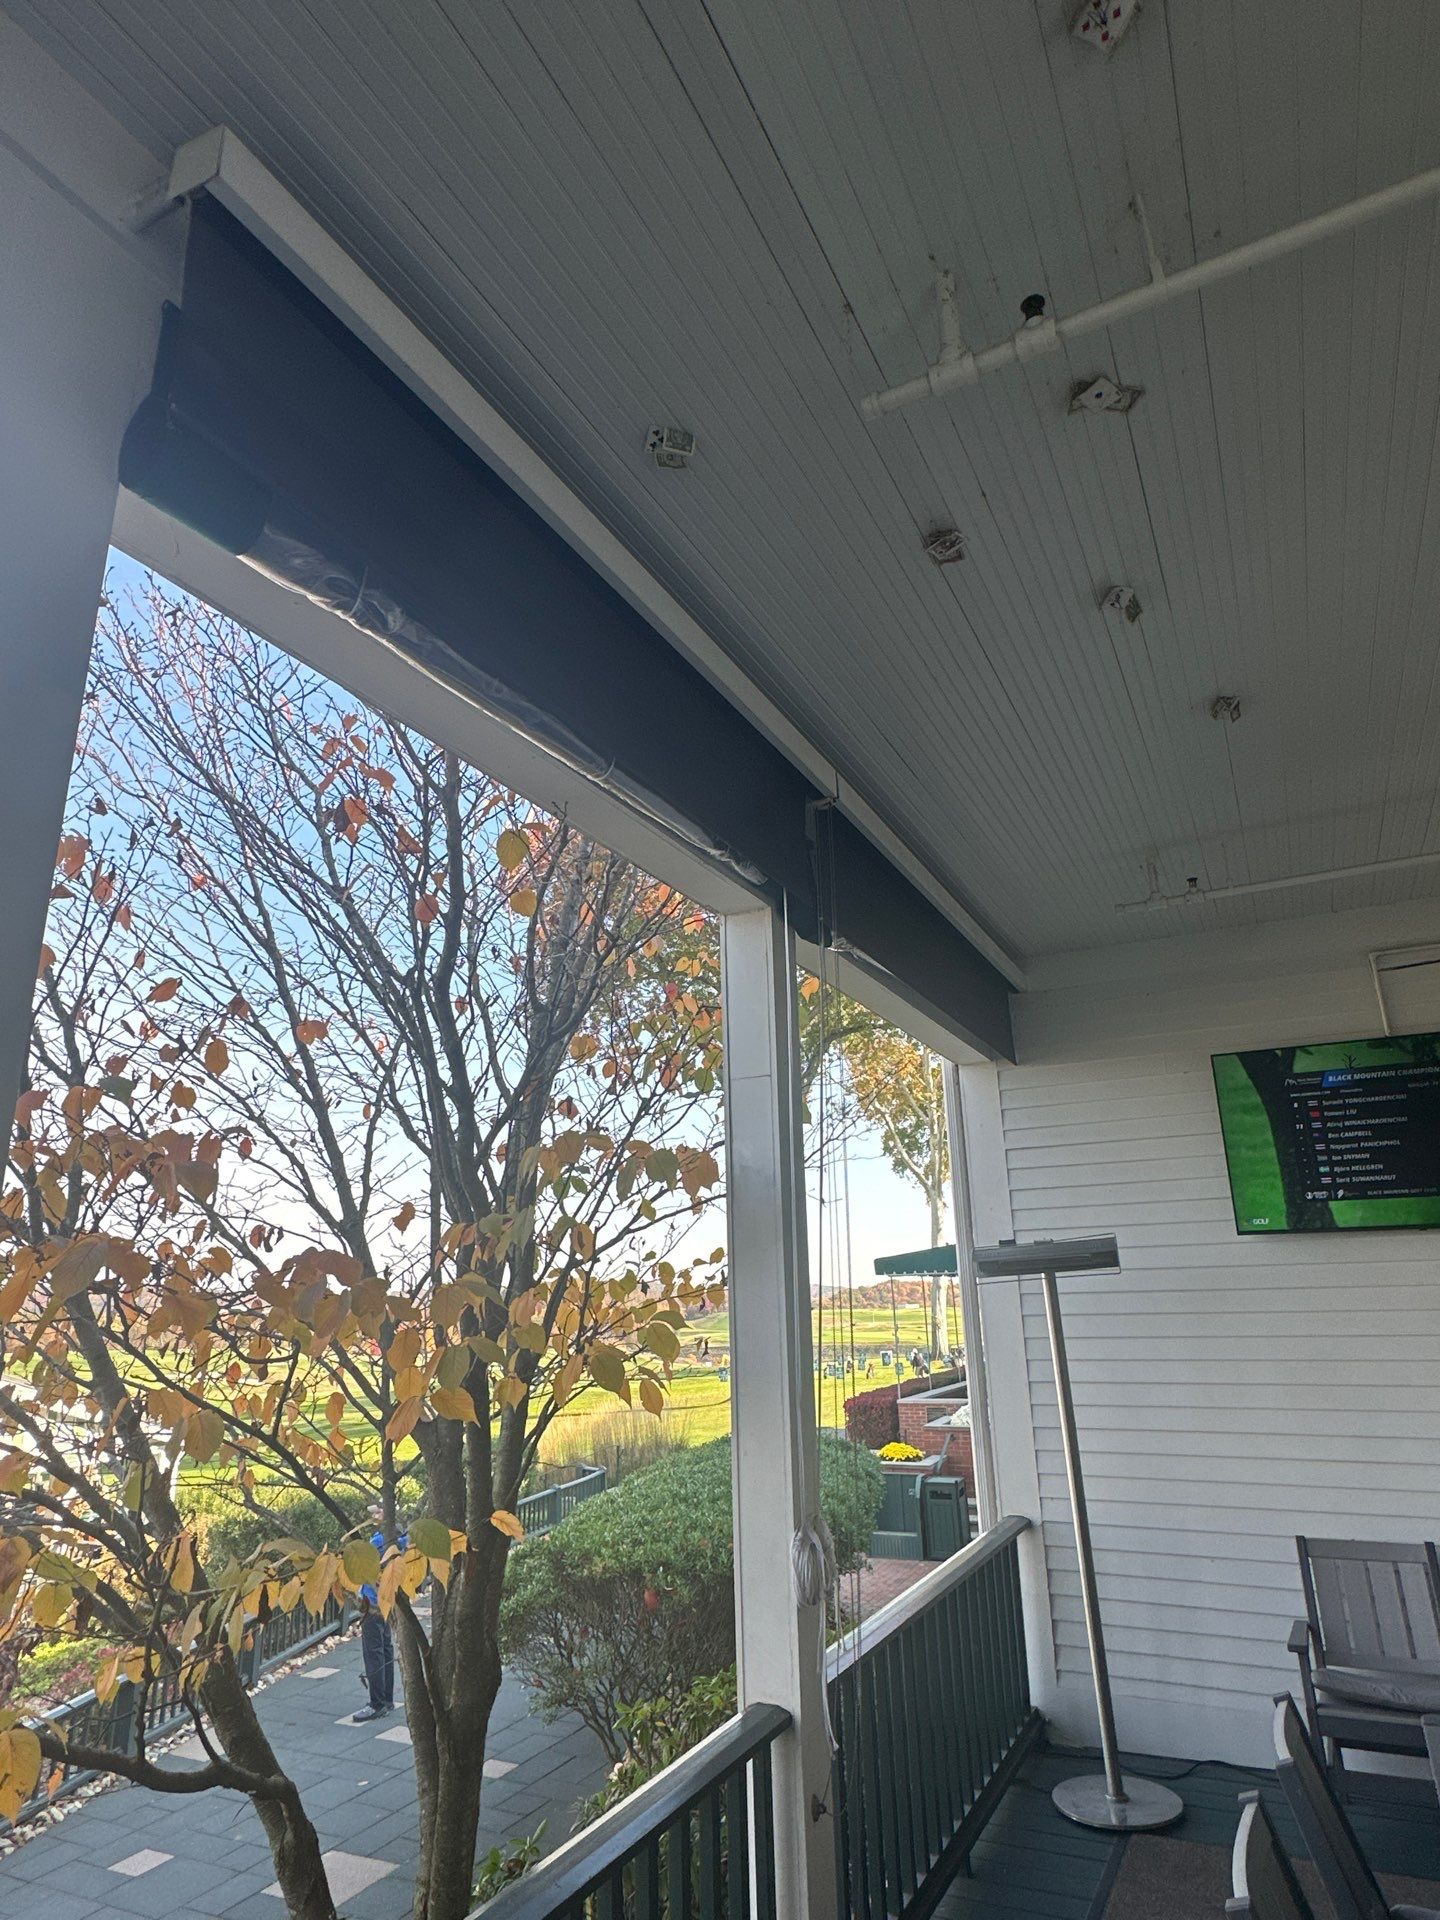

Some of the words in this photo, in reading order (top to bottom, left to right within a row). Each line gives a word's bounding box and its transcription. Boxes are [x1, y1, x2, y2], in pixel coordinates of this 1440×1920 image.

[1328, 1074, 1352, 1082] BLACK
[1353, 1070, 1396, 1080] MOUNTAIN
[1340, 1130, 1373, 1138] CAMPBELL
[1252, 1217, 1269, 1225] GOLF
